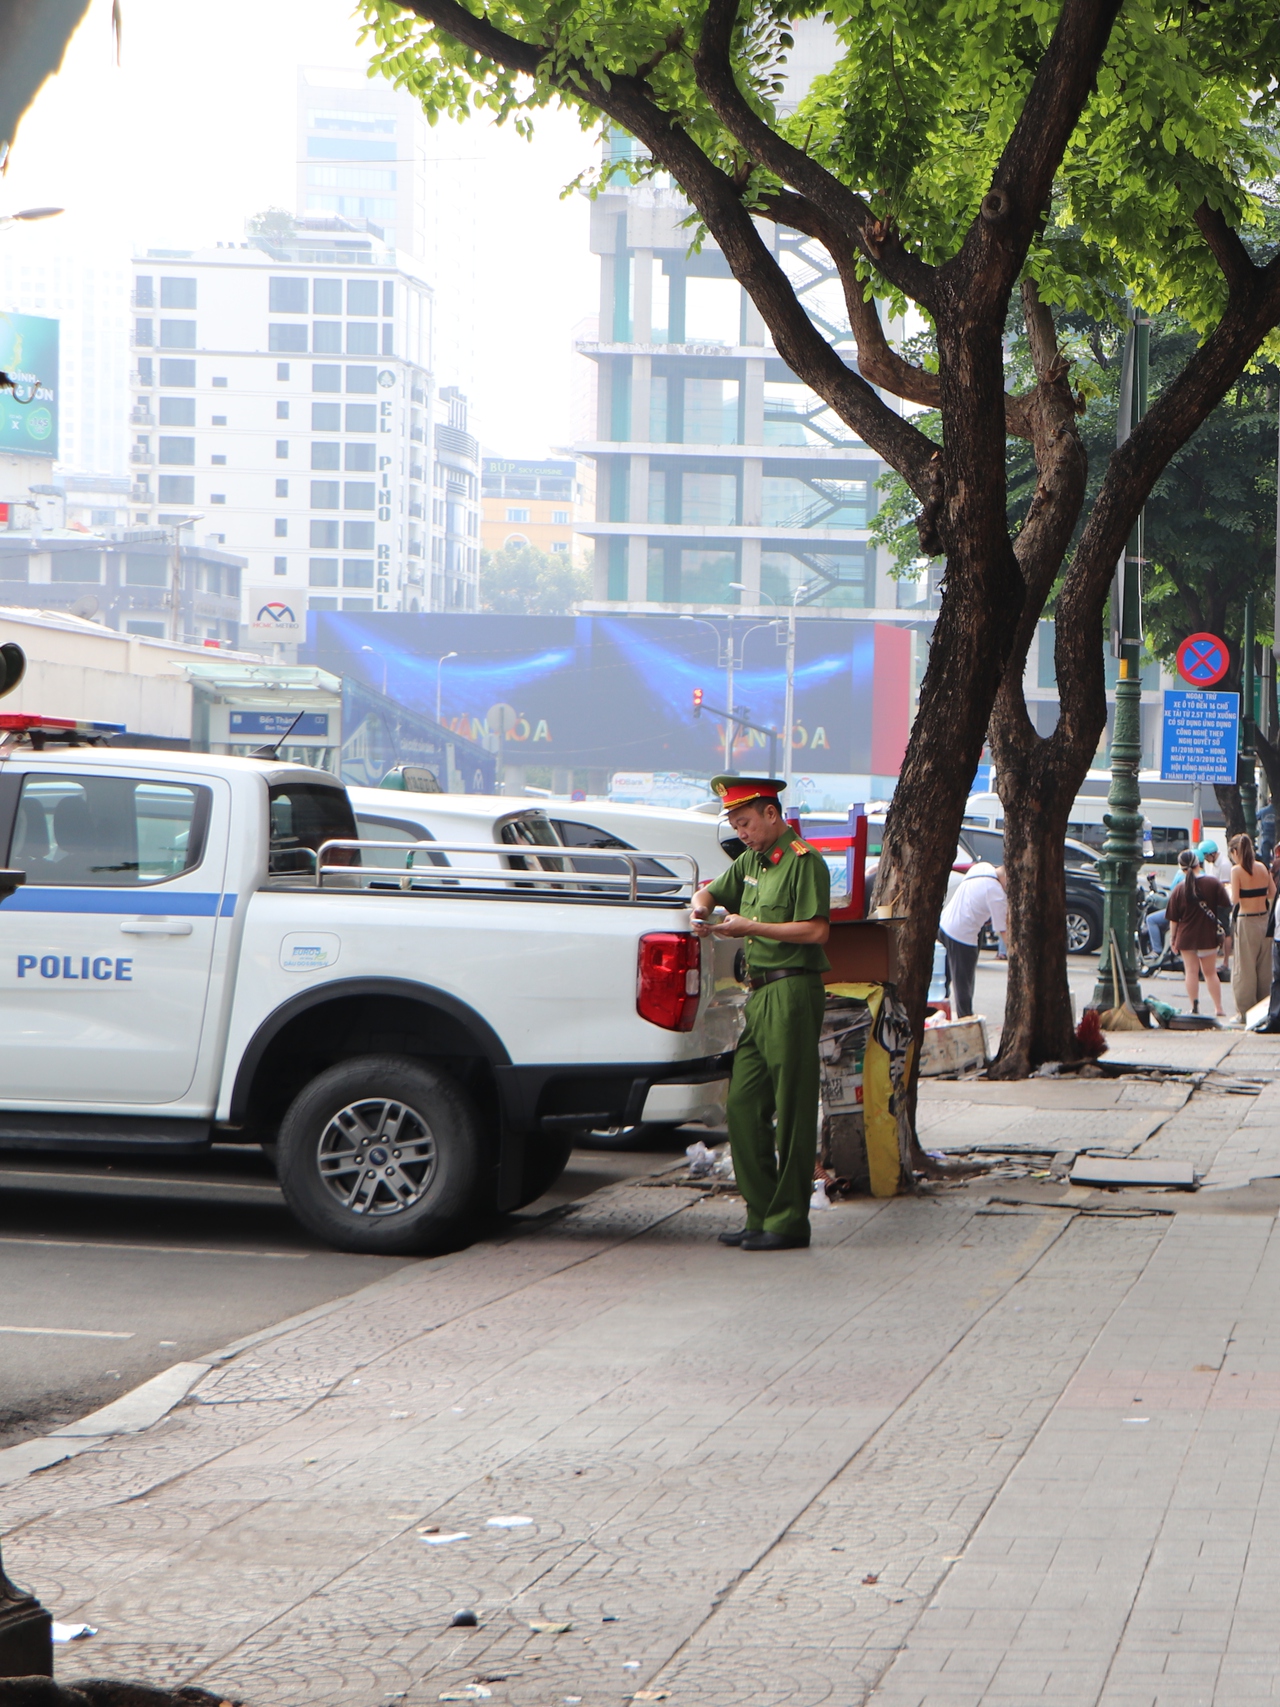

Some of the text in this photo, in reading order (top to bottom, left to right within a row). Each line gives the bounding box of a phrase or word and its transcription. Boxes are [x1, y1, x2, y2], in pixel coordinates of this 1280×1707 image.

[380, 401, 392, 433] EL
[490, 460, 516, 472] BÚP
[378, 456, 392, 522] PINO
[377, 544, 390, 610] REAL
[1217, 710, 1236, 719] XUỐNG
[17, 954, 133, 981] POLICE
